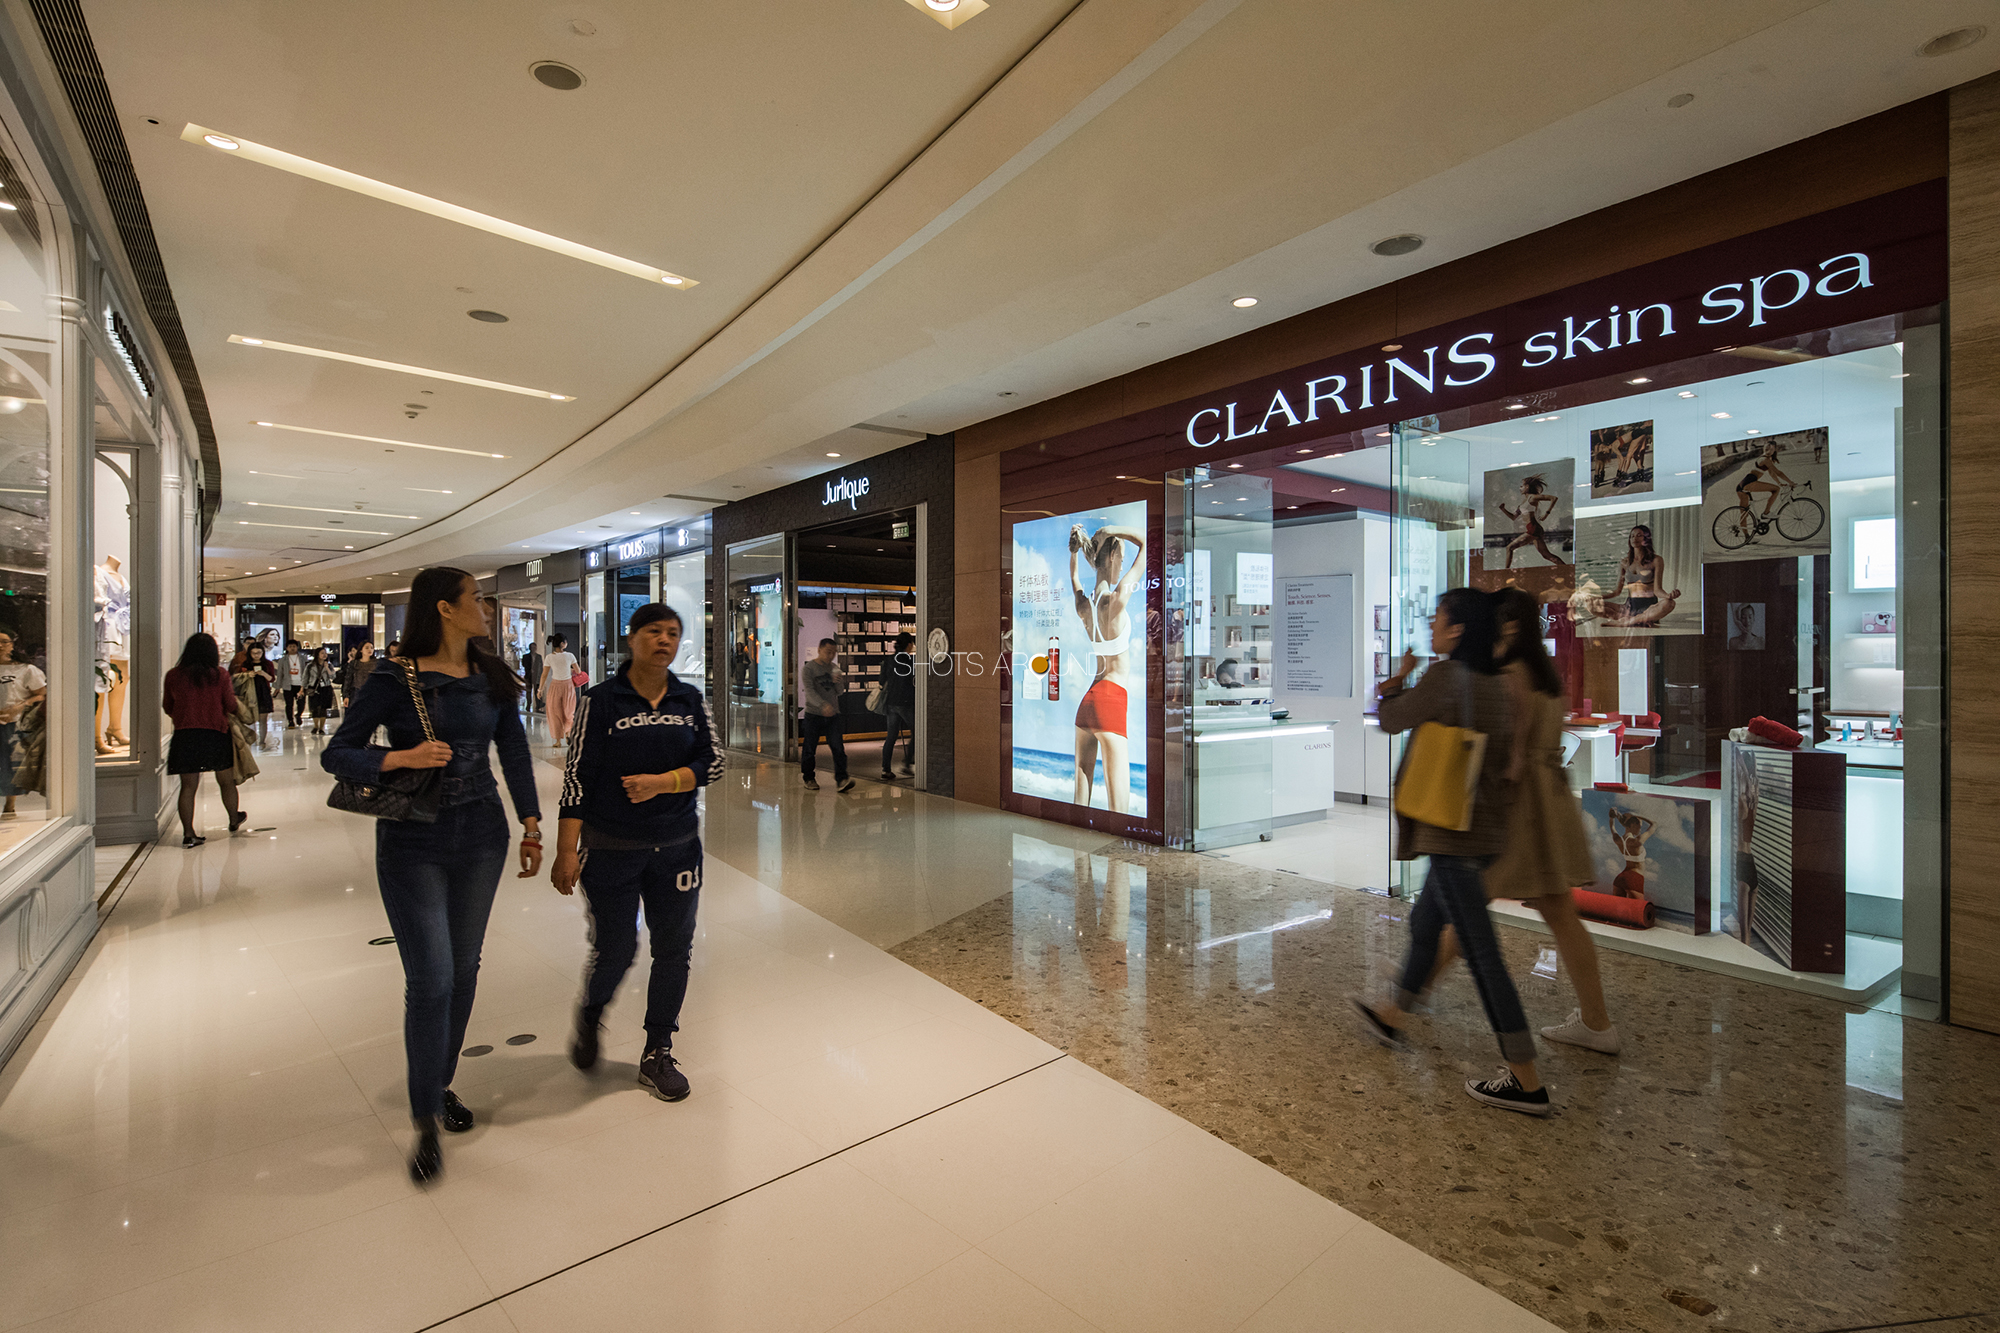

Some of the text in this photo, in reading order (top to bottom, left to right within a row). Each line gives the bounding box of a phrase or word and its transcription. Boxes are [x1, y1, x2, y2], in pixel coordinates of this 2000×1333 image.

[1186, 252, 1874, 448] CLARINS skin spa
[822, 476, 870, 511] Jurlique
[1124, 577, 1161, 595] TOUS
[615, 711, 685, 730] adidas
[1304, 742, 1332, 750] CLARINS
